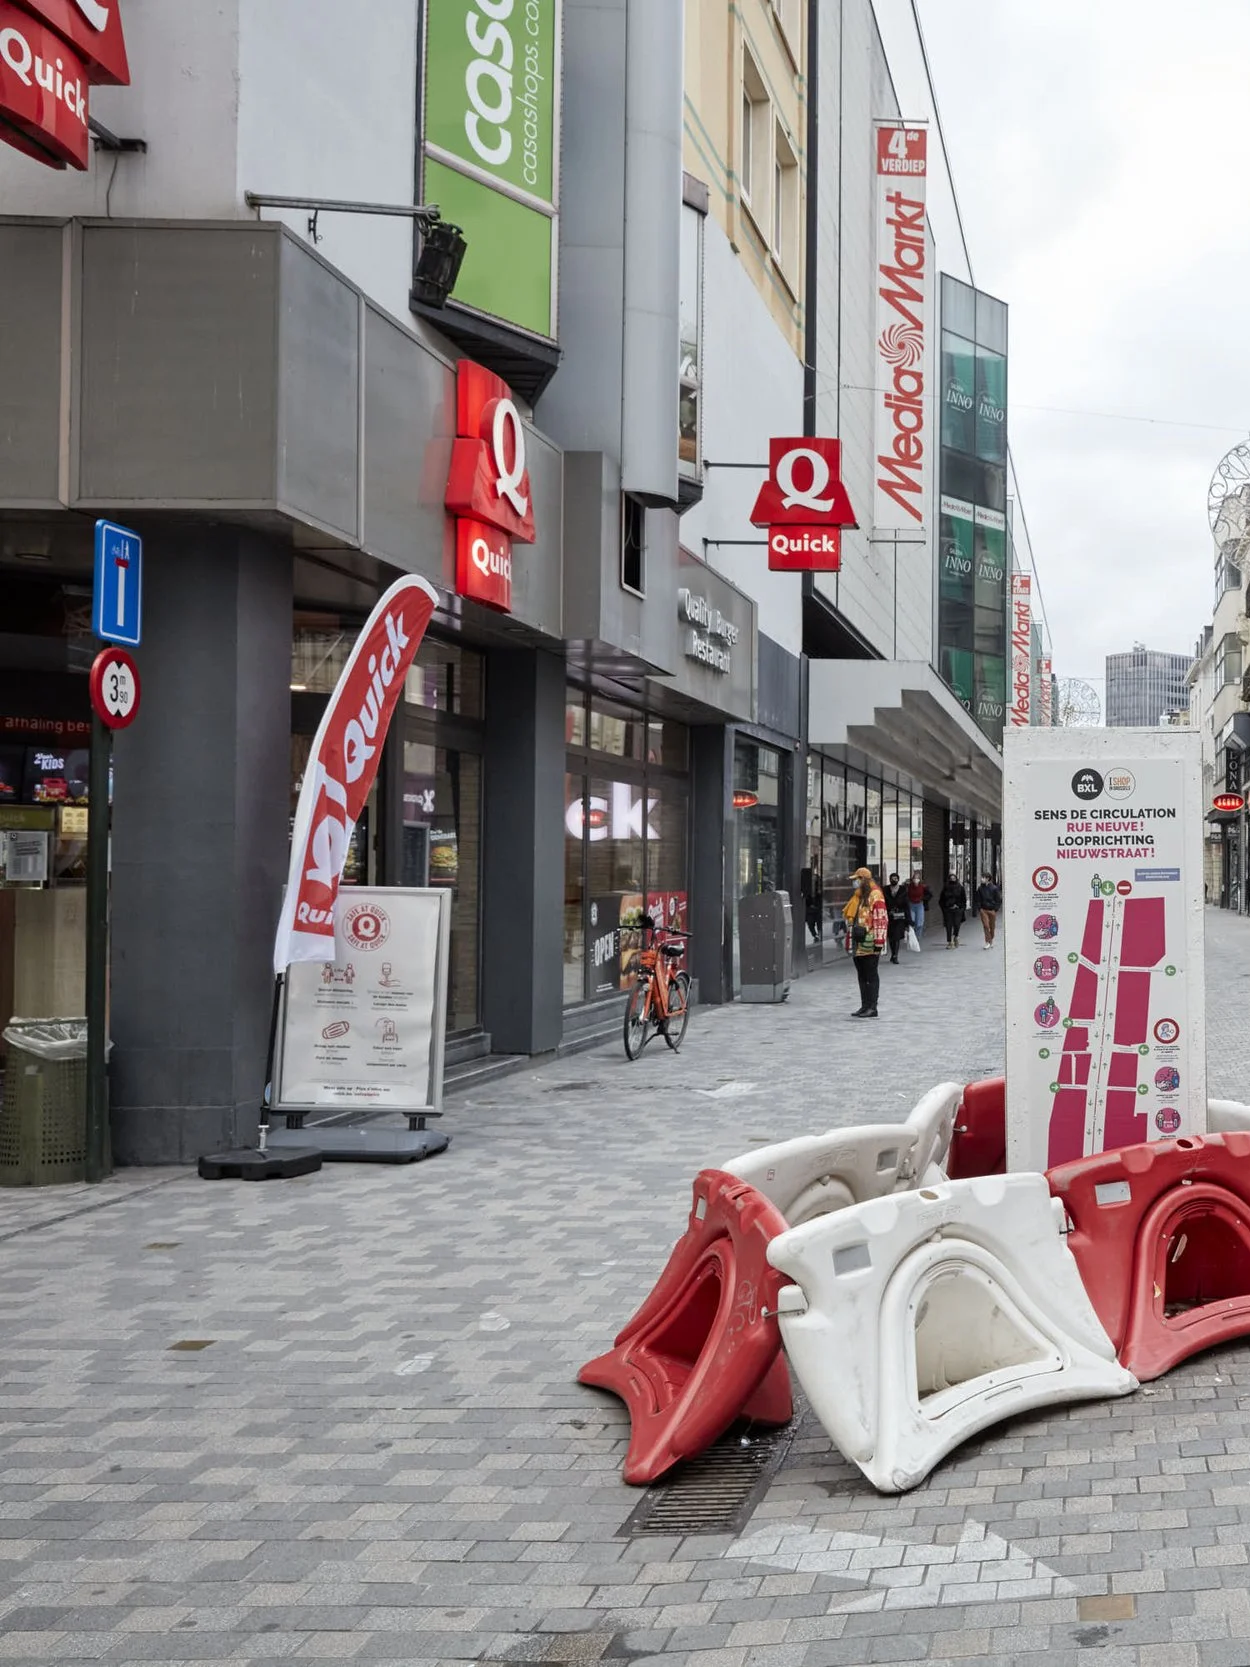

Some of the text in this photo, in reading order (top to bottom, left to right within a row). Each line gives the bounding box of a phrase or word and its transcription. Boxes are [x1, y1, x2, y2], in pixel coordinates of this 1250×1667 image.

[0, 27, 87, 127] Quick
[516, 0, 544, 185] casashops.co
[881, 158, 926, 173] VERDIEP
[946, 389, 973, 410] INNO
[979, 403, 1004, 422] INNO
[491, 398, 528, 517] Q
[776, 447, 835, 512] Q
[771, 533, 836, 555] Quick
[945, 555, 971, 573] INNO
[978, 564, 1003, 581] INNO
[682, 588, 712, 633] Quality
[713, 609, 739, 646] Burger
[689, 629, 731, 674] Restaurant
[344, 611, 409, 783] Quick
[978, 702, 1002, 718] INNO
[41, 758, 65, 770] KIDS
[1077, 784, 1098, 793] BXL
[1113, 777, 1131, 785] SHOP
[1034, 808, 1176, 820] SENS DE CIRCULATION
[1066, 822, 1092, 832] RUE
[1057, 835, 1154, 846] LOOPRICHTING
[594, 931, 615, 967] OPEN
